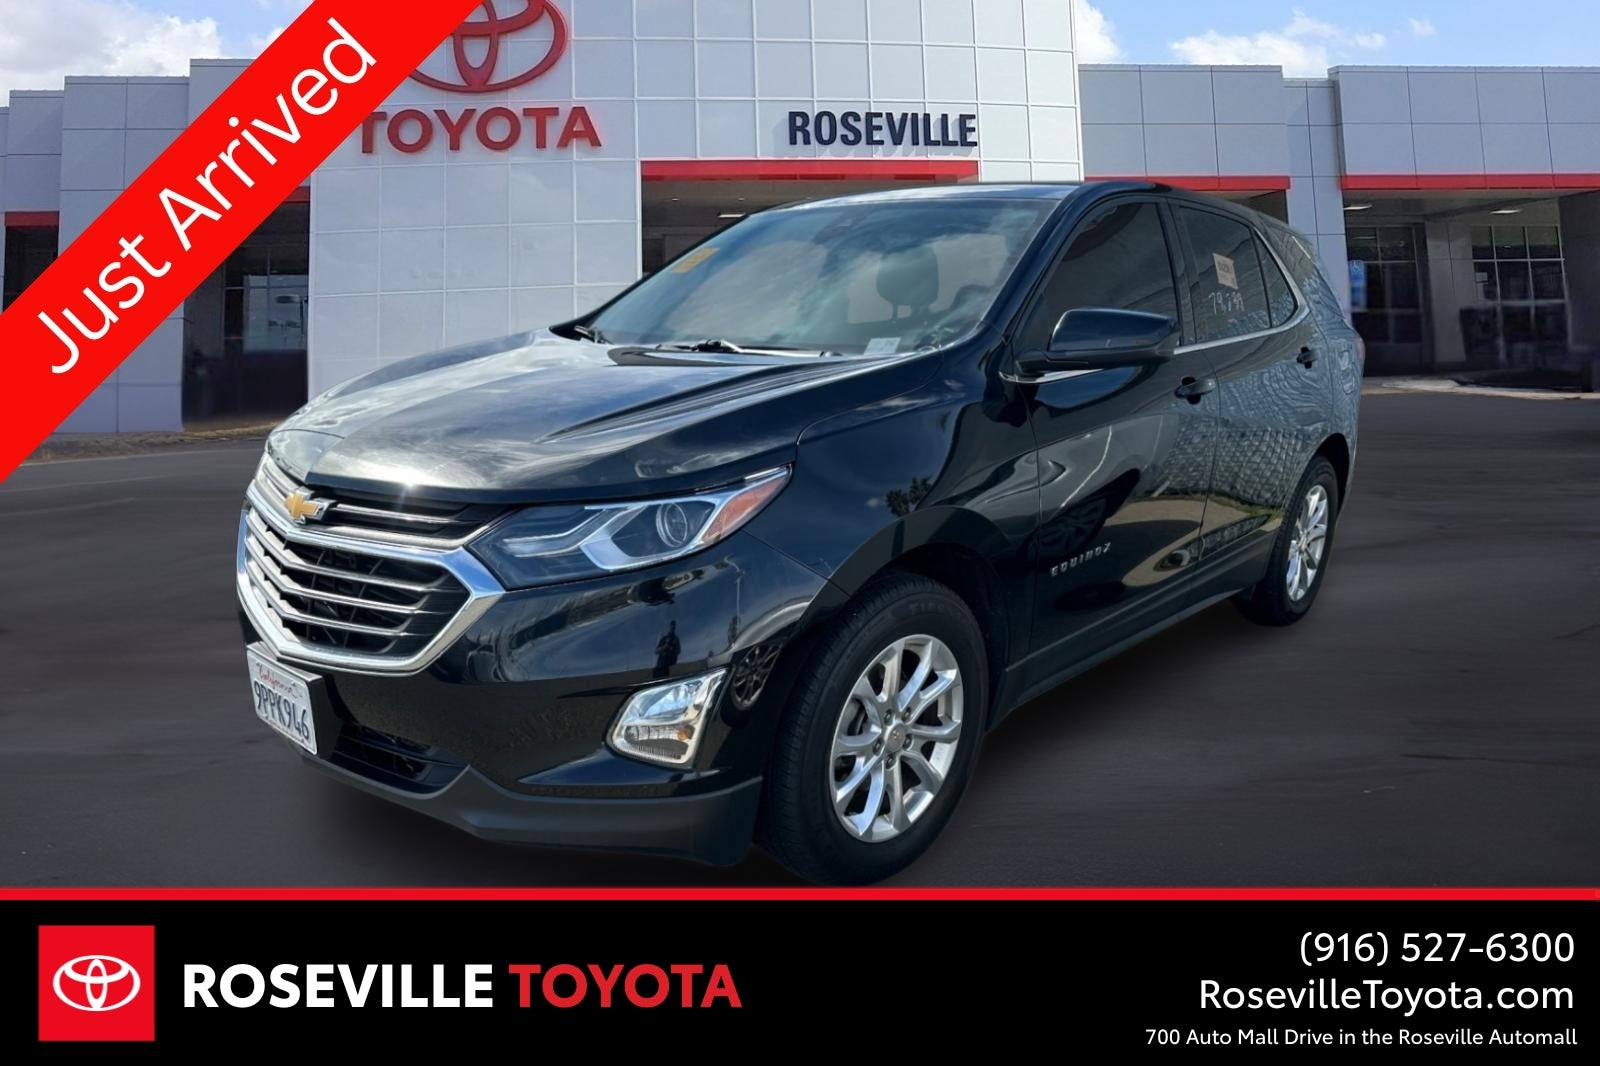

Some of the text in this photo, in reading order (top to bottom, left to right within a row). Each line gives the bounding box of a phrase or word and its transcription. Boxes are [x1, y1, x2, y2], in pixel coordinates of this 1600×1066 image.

[361, 106, 601, 154] TOYOTA
[788, 110, 979, 148] ROSEVILLE
[1050, 541, 1112, 577] EQUINOX
[254, 680, 310, 741] 9PPK946
